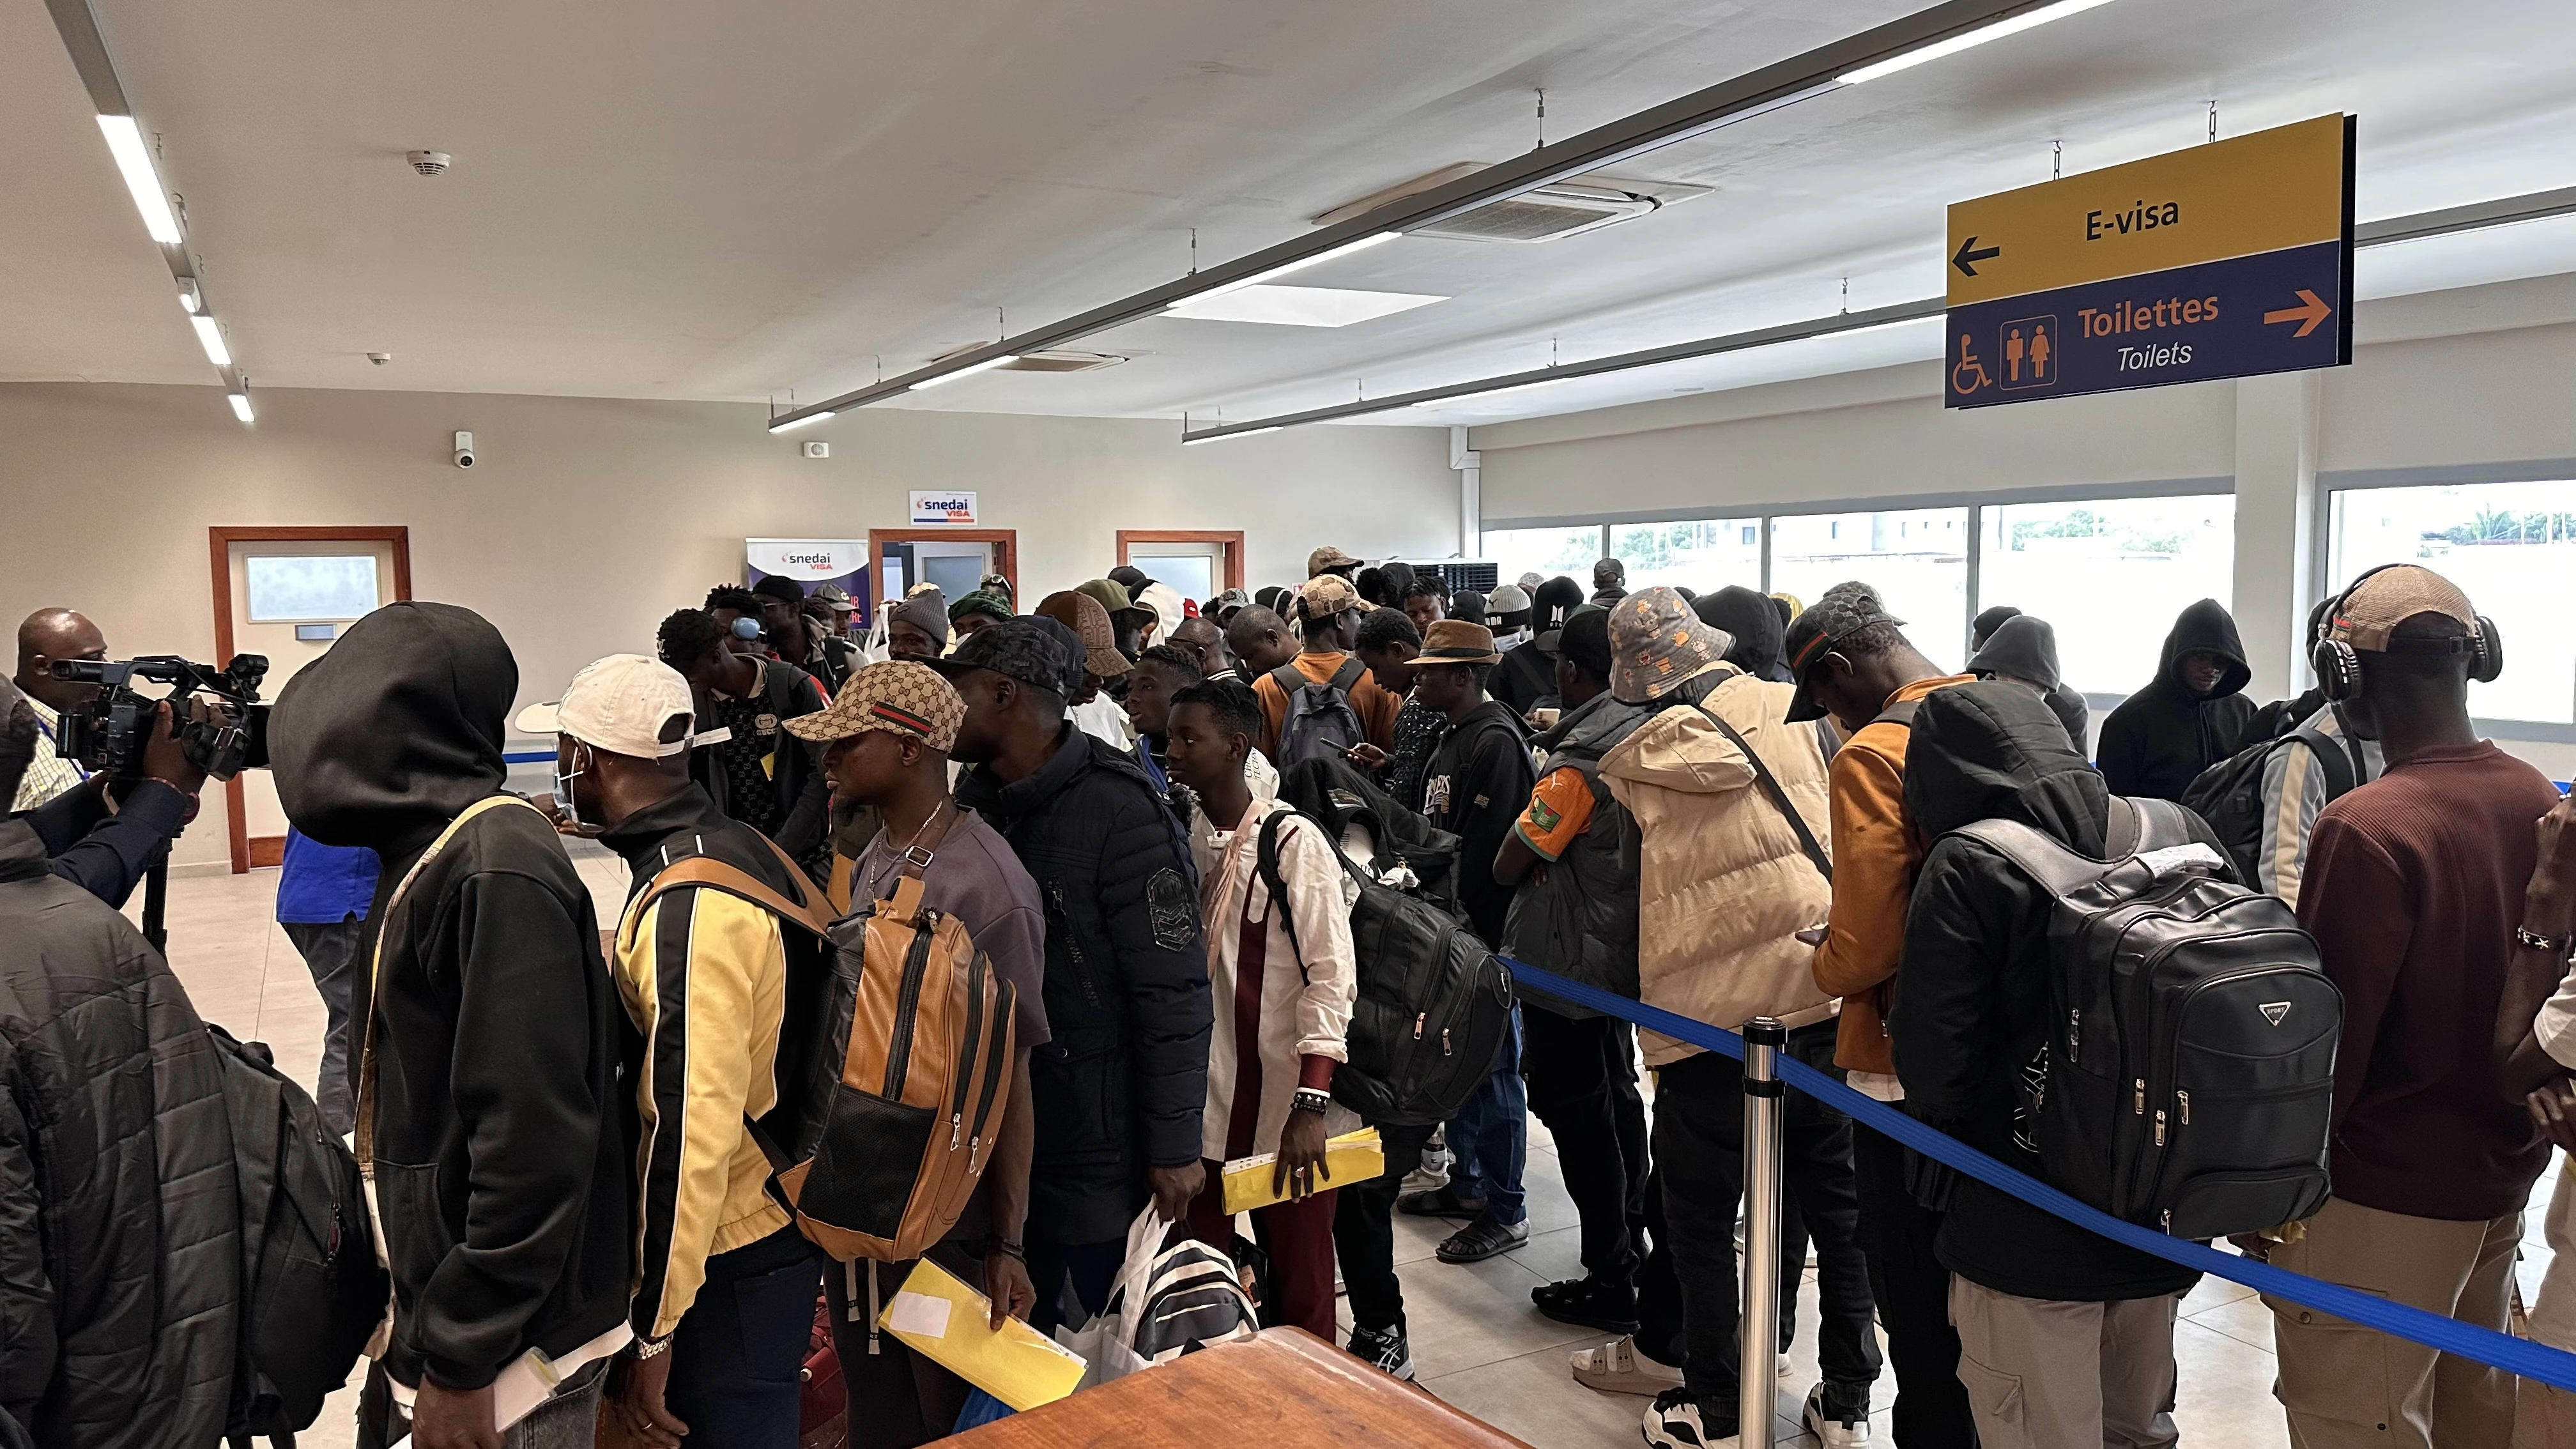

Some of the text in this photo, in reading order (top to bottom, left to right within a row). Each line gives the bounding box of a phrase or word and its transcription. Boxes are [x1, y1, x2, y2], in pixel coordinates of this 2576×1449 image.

[2087, 200, 2179, 240] E-visa
[2078, 296, 2219, 338] Toilettes
[2117, 341, 2193, 371] Toilets
[924, 499, 967, 510] snedai
[789, 553, 831, 563] snedai
[1485, 616, 1501, 626] UMA
